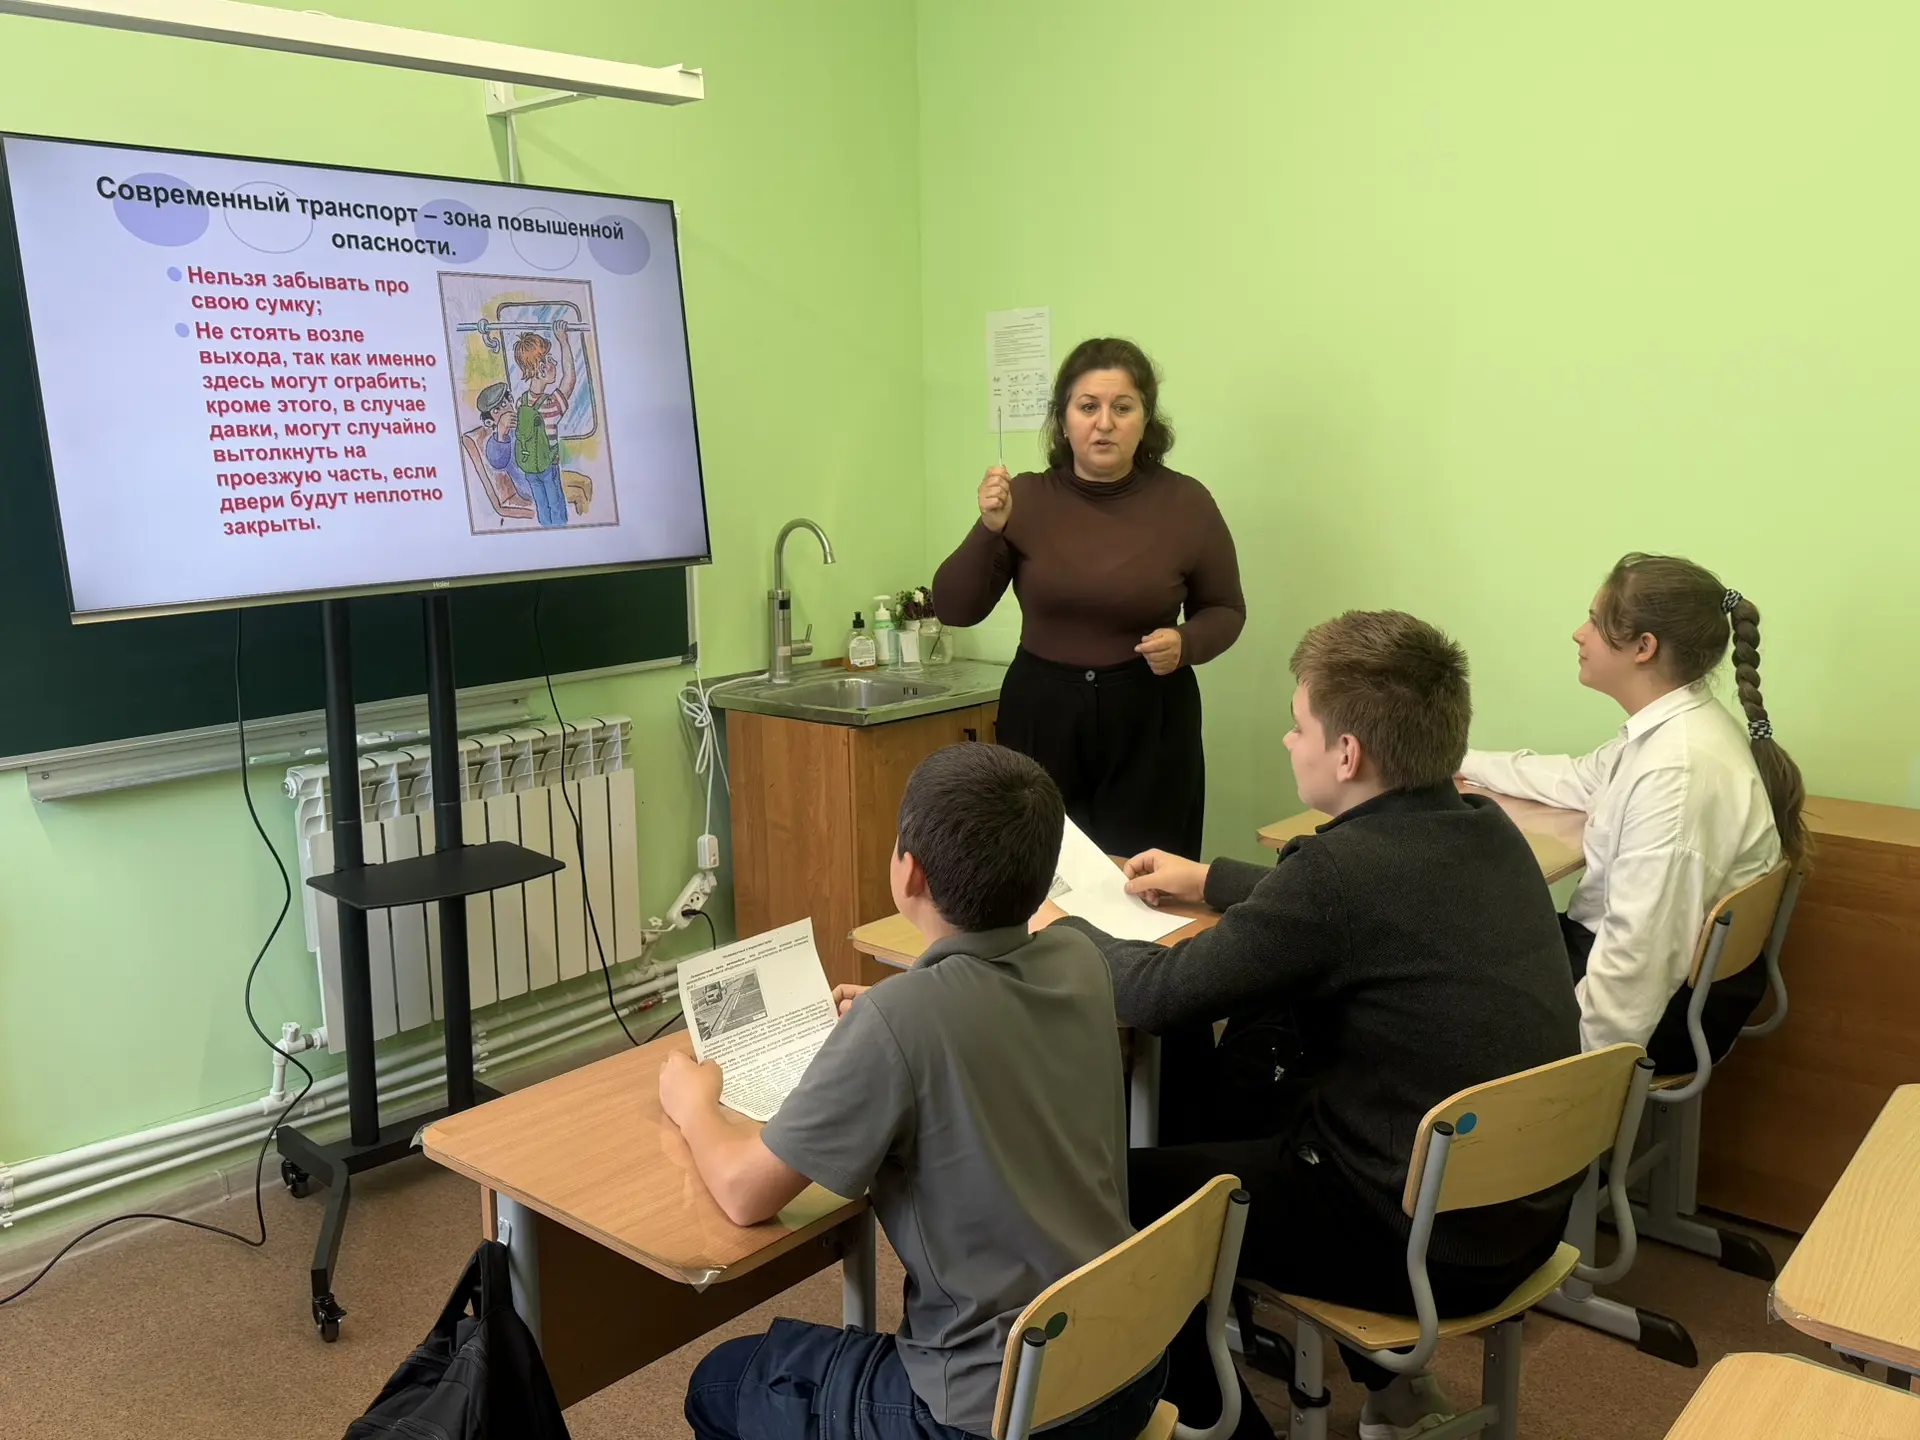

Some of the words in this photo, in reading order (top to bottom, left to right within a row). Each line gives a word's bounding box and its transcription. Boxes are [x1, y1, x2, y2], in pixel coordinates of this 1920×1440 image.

[96, 175, 291, 213] Современный
[296, 197, 418, 226] транспорт
[443, 210, 492, 229] зона
[498, 214, 624, 240] повышенной
[331, 232, 457, 256] опасности.
[187, 265, 267, 287] Нельзя
[273, 271, 369, 292] забывать
[375, 278, 409, 296] про
[191, 294, 249, 310] свою
[255, 297, 323, 316] сумку;
[195, 321, 224, 340] Не
[230, 326, 301, 341] стоять
[307, 328, 365, 342] возле
[199, 350, 288, 368] выхода,
[292, 351, 326, 365] так
[331, 351, 362, 366] как
[366, 351, 437, 367] именно
[202, 375, 264, 392] здесь
[271, 375, 328, 393] могут
[334, 373, 427, 392] ограбить;
[206, 398, 271, 417] кроме
[278, 399, 338, 415] этого,
[344, 400, 355, 413] в
[361, 399, 426, 416] случае
[209, 423, 279, 440] давки,
[284, 422, 341, 439] могут
[347, 418, 437, 439] случайно
[213, 446, 338, 464] вытолкнуть
[344, 445, 367, 459] на
[216, 470, 322, 490] проезжую
[328, 467, 388, 483] часть,
[393, 465, 438, 479] если
[219, 494, 285, 513] двери
[290, 490, 348, 511] будут
[354, 487, 443, 504] неплотно
[223, 517, 321, 537] закрыты.
